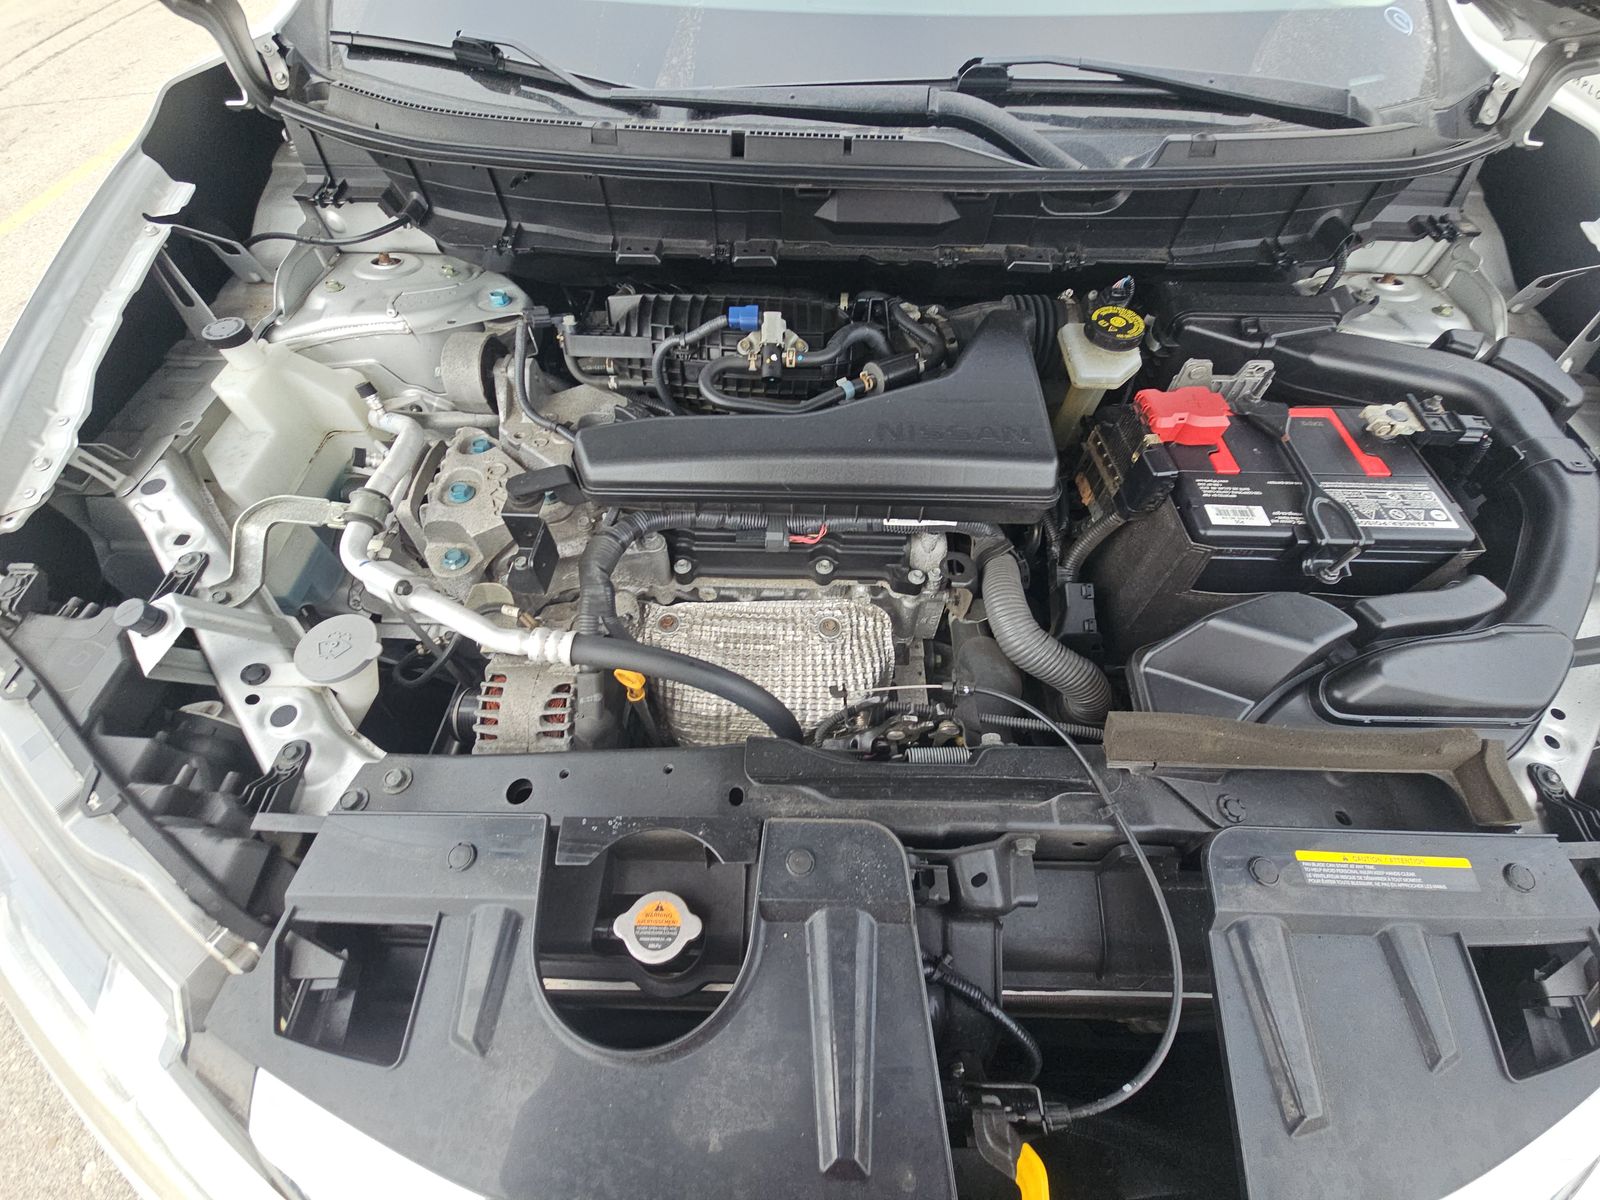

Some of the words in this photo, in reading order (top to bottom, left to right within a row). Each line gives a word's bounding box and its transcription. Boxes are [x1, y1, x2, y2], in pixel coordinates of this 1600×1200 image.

[876, 422, 1033, 444] NISSAN
[1352, 856, 1382, 864] CAUTION
[1389, 857, 1425, 865] ATTENTION
